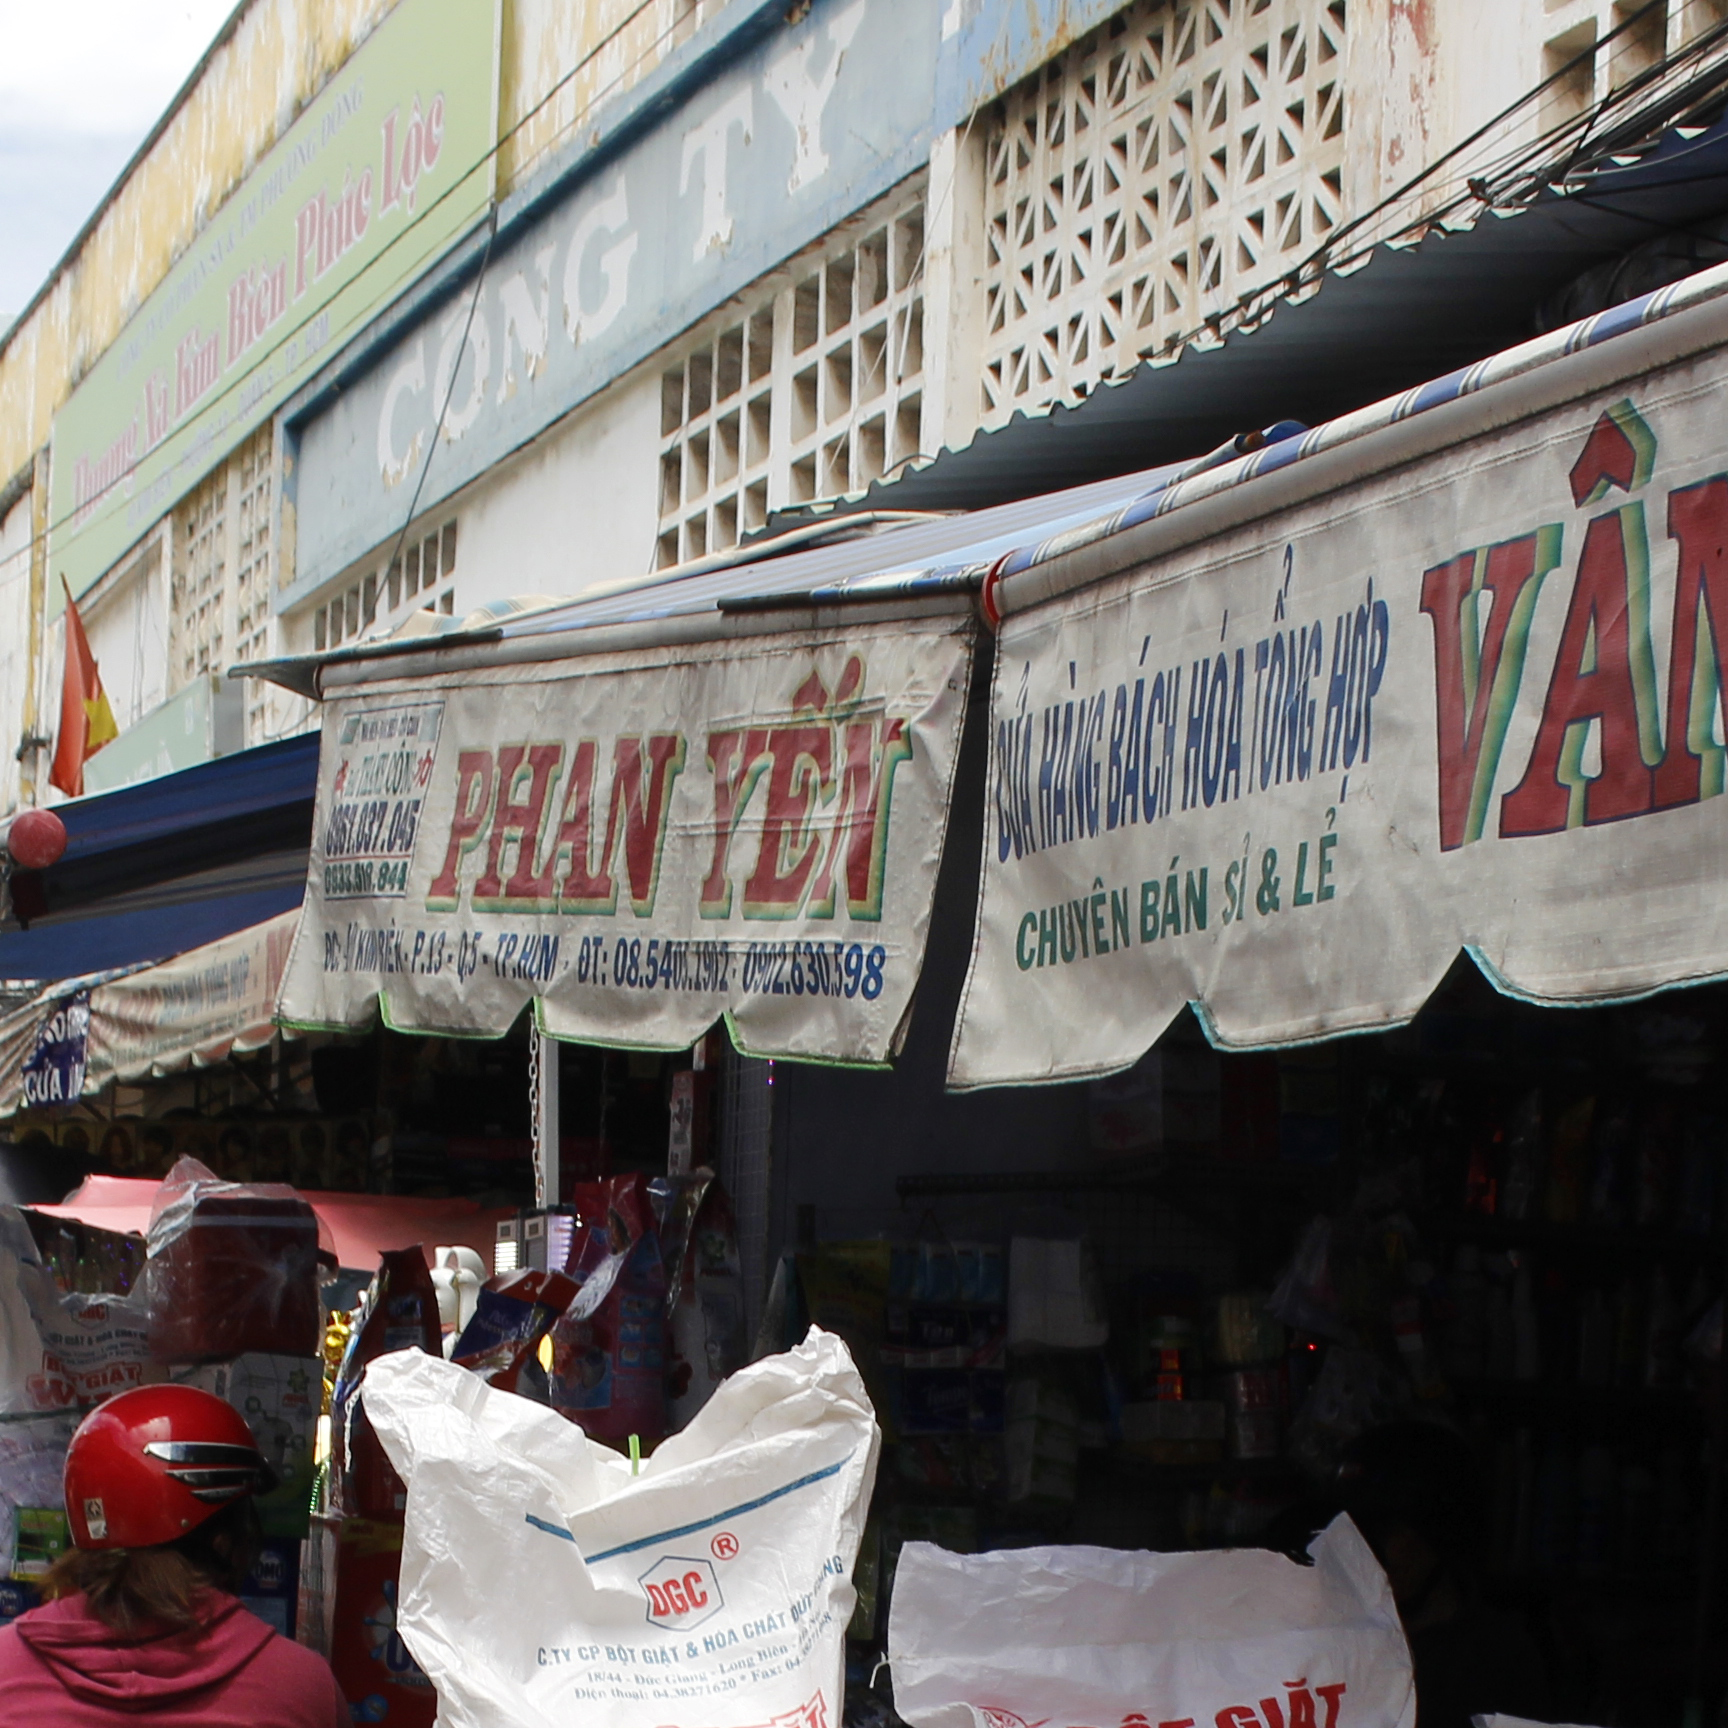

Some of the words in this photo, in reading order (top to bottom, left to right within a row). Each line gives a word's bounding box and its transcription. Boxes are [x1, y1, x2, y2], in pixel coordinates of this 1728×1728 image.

[292, 164, 373, 305] Phúc
[379, 90, 445, 216] Lộc
[376, 167, 638, 486] CÔNG
[680, 5, 862, 262] TY
[427, 732, 685, 916] PHAN
[698, 653, 914, 922] YẾN
[997, 661, 1036, 864] CỬA
[1039, 661, 1106, 850] HÀNG
[1106, 635, 1181, 831] BÁCH
[1182, 610, 1244, 811] HÓA
[1247, 544, 1322, 794] TỔNG
[1319, 577, 1388, 803] HỢP
[741, 940, 886, 1001] 0902.630.598
[1016, 876, 1130, 971] CHUYÊN
[1140, 856, 1208, 943] BÁN
[1222, 832, 1251, 925] SỈ
[1256, 848, 1281, 915] &
[1292, 807, 1338, 907] LẺ
[537, 1646, 571, 1667] C.TY
[578, 1645, 601, 1660] CP
[606, 1644, 636, 1670] BỘT
[642, 1645, 680, 1667] GIẶT
[686, 1641, 699, 1658] &
[703, 1628, 739, 1653] HÓA
[743, 1608, 787, 1640] CHẤT
[646, 1571, 708, 1617] DGC
